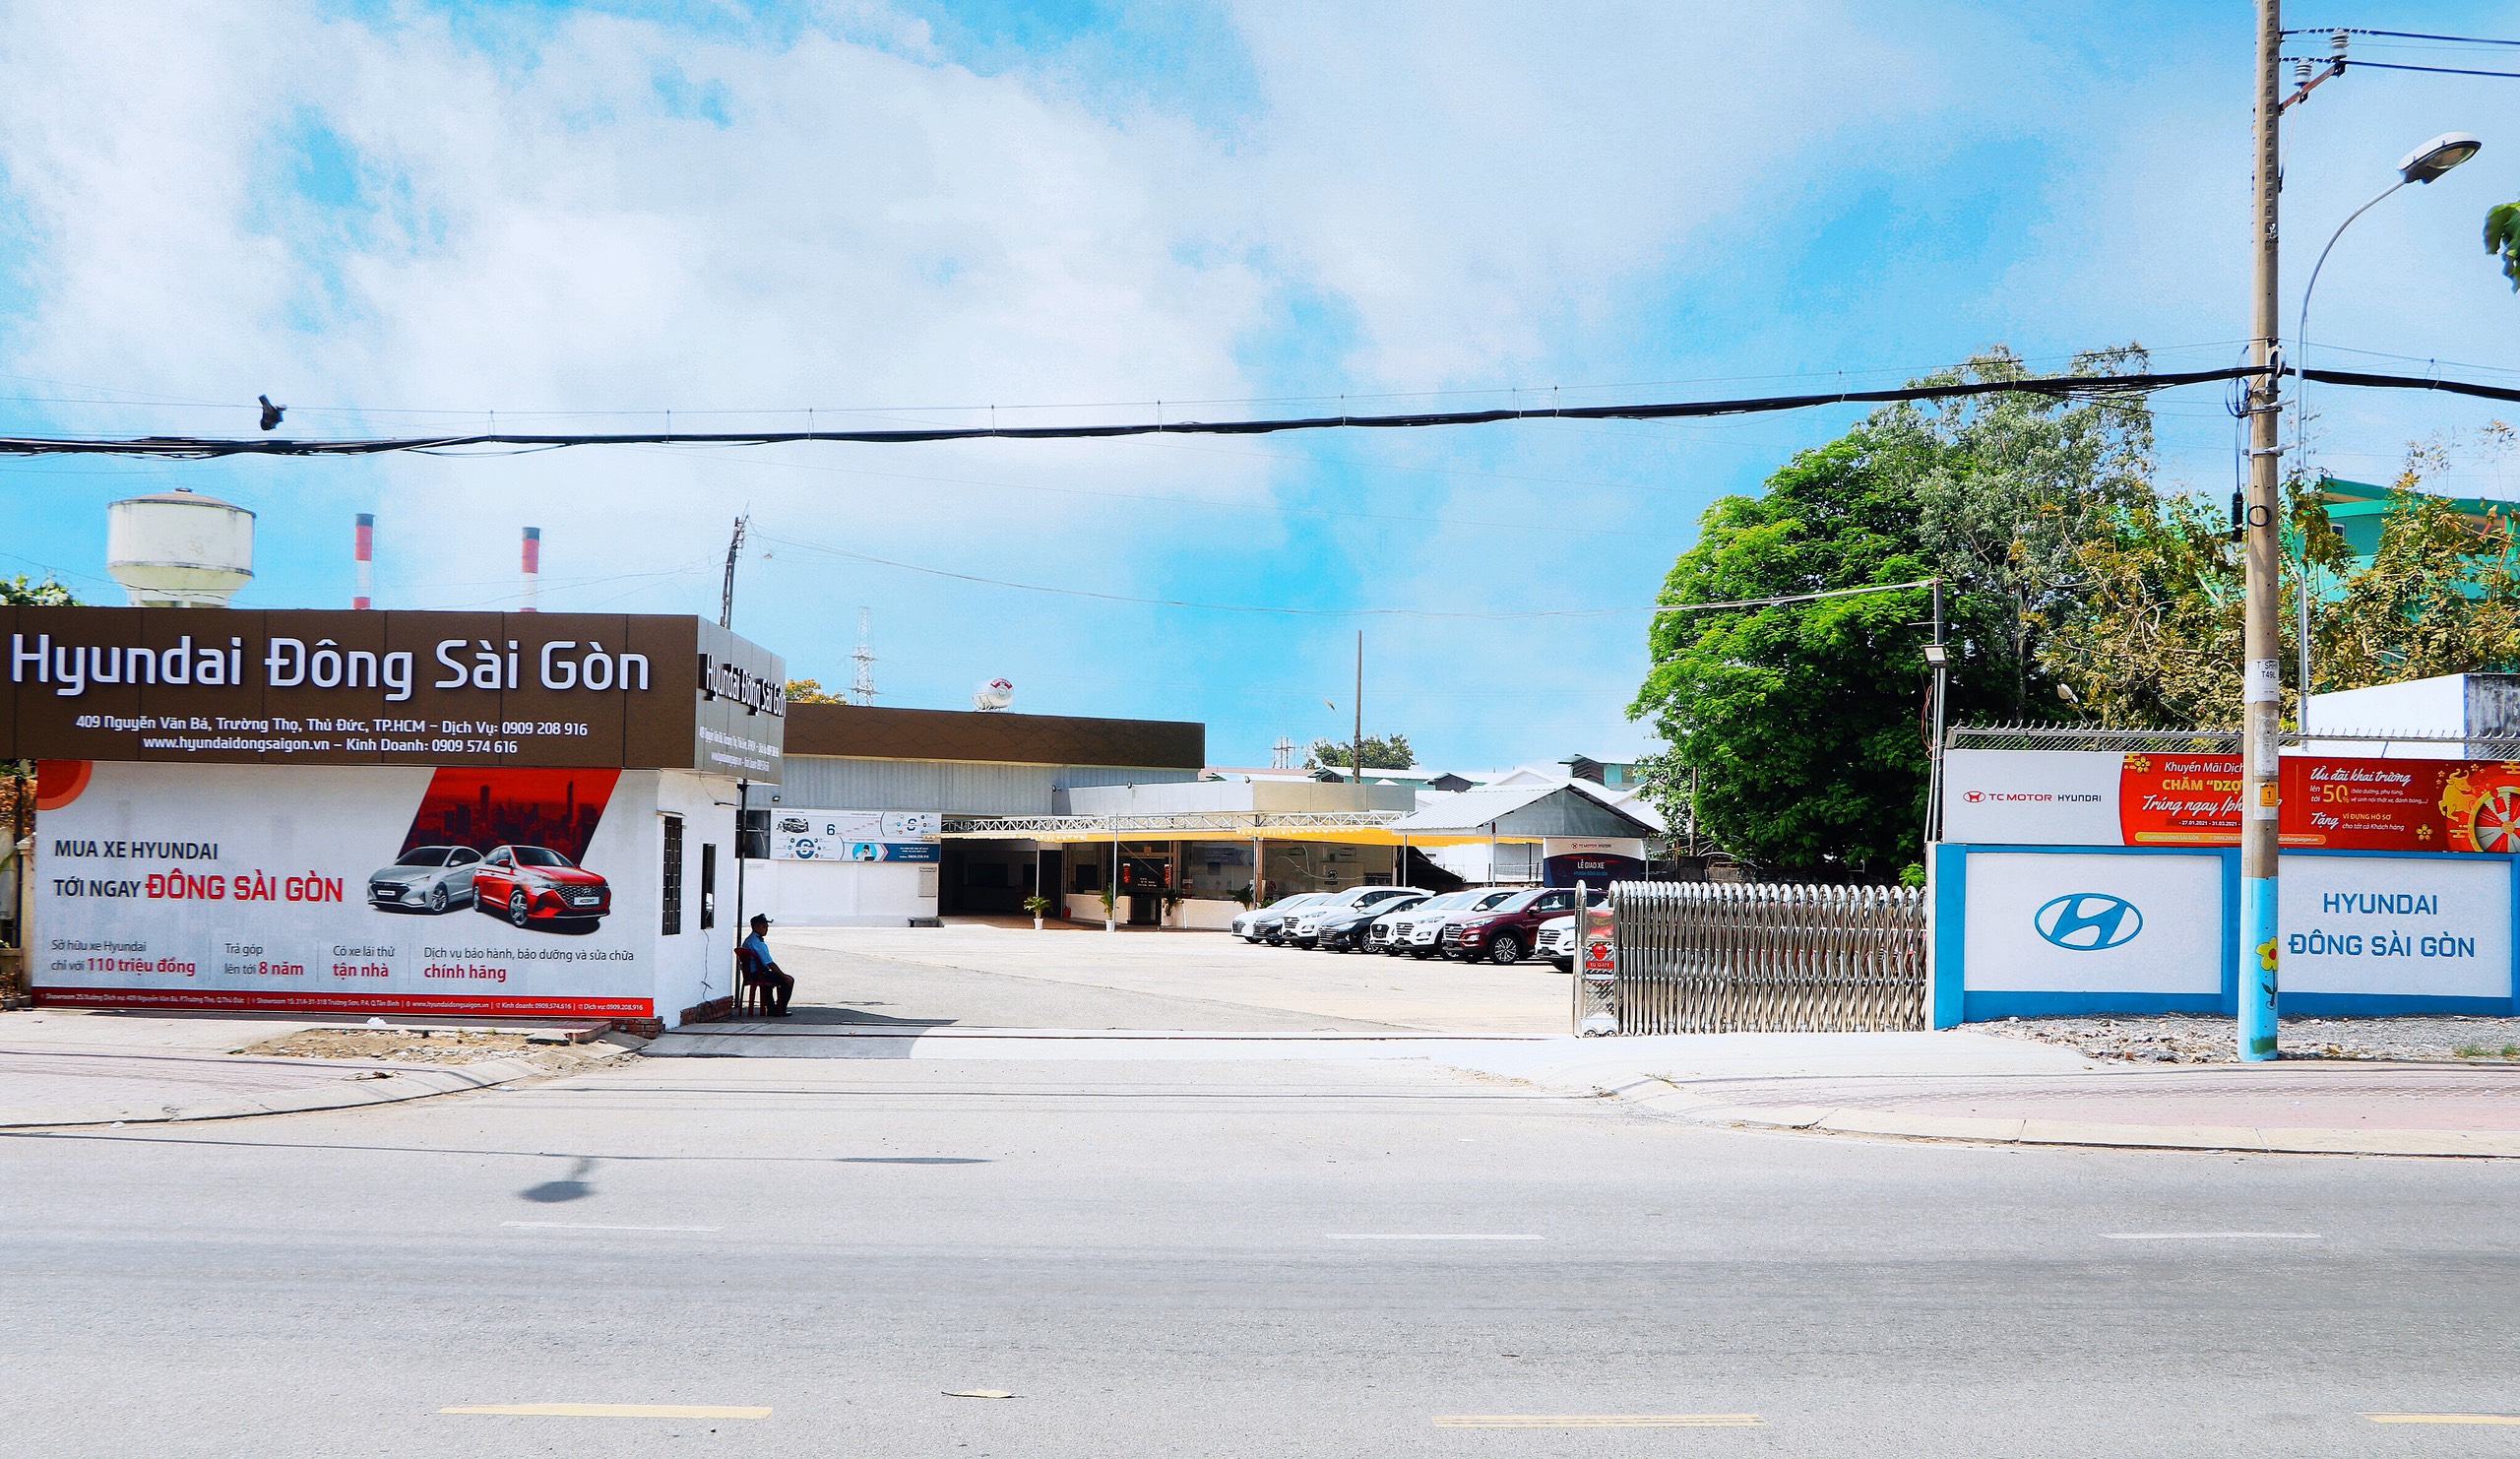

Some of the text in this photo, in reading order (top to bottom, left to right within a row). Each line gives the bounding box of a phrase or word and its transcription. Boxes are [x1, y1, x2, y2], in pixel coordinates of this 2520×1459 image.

[12, 633, 650, 701] Hyundai Đông Sài Gòn
[76, 715, 588, 736] 409 Nguyễn Văn Bá, Trường Thọ, Thủ Đức, TP.HCM Dịch Vụ: 0909 208 916
[143, 736, 518, 754] www.hyundaidongsaigon.vn Kinh Doanh: 0909 574 616
[2164, 761, 2201, 775] Khuyến
[2202, 762, 2222, 773] Mãi
[2162, 776, 2204, 792] CHĂM
[1989, 793, 2102, 802] TC MOTOR HYUNDAI
[2184, 801, 2219, 817] ngay
[827, 824, 836, 835] 6
[54, 840, 219, 860] MUA XE HYUNDAI
[53, 868, 343, 902] TỚI NGAY ĐÔNG SÀI GÒN
[2323, 892, 2438, 916] HYUNDAI
[89, 942, 101, 951] xe
[103, 940, 147, 954] Hyundai
[348, 947, 361, 957] xe
[2288, 928, 2476, 958] ĐÔNG SÀI GÒN
[424, 947, 447, 960] Dịch
[449, 949, 462, 961] vụ
[465, 947, 484, 959] bảo
[486, 947, 515, 961] hành,
[517, 948, 536, 960] bảo
[539, 949, 573, 962] dưỡng
[575, 949, 587, 960] và
[608, 949, 634, 961] chữa
[88, 958, 115, 972] 110
[118, 957, 154, 976] triệu
[259, 961, 268, 975] 8
[272, 961, 304, 976] năm
[333, 962, 389, 981] tận nhà
[424, 963, 506, 983] chính hãng
